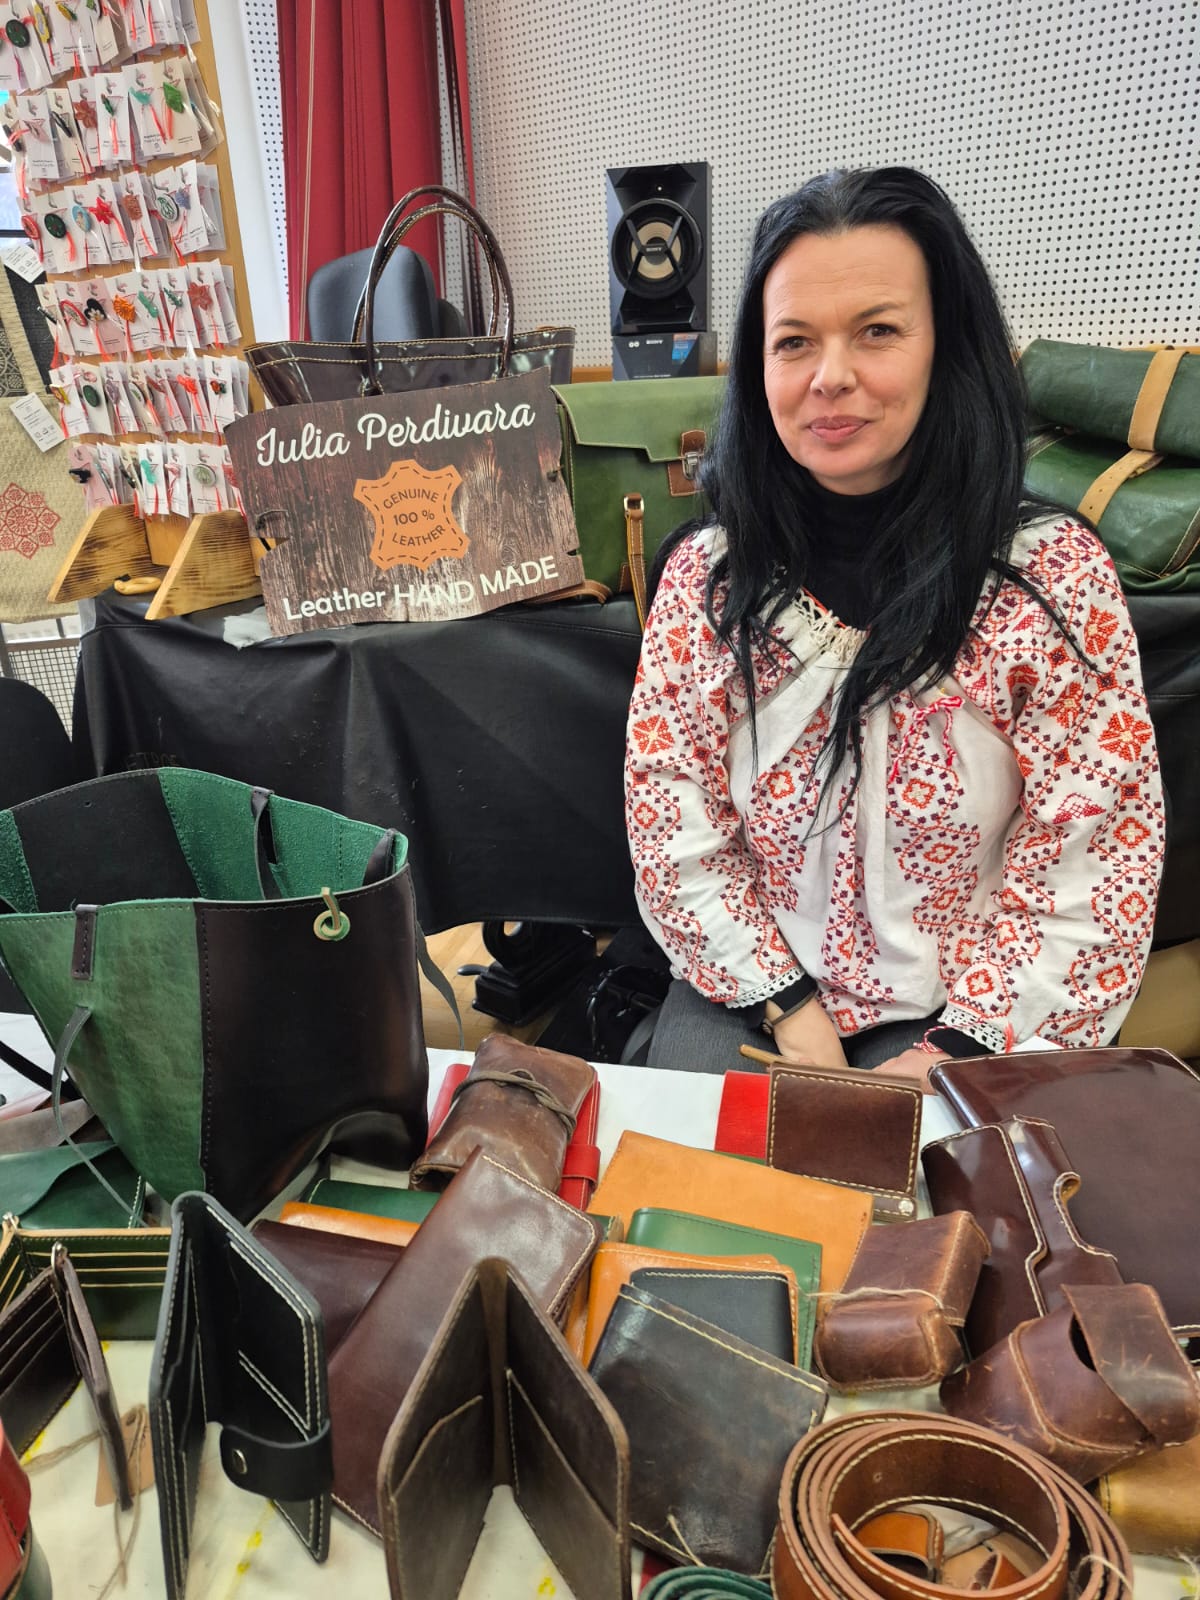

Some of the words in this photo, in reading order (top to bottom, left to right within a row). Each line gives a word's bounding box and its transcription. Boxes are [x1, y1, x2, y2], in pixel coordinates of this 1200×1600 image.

[357, 403, 536, 451] Perdivara
[383, 488, 440, 511] GENUINE
[393, 511, 418, 526] 100
[421, 509, 435, 522] %
[392, 524, 446, 548] LEATHER
[282, 587, 386, 621] Leather
[394, 580, 475, 607] HAND
[479, 555, 559, 596] MADE
